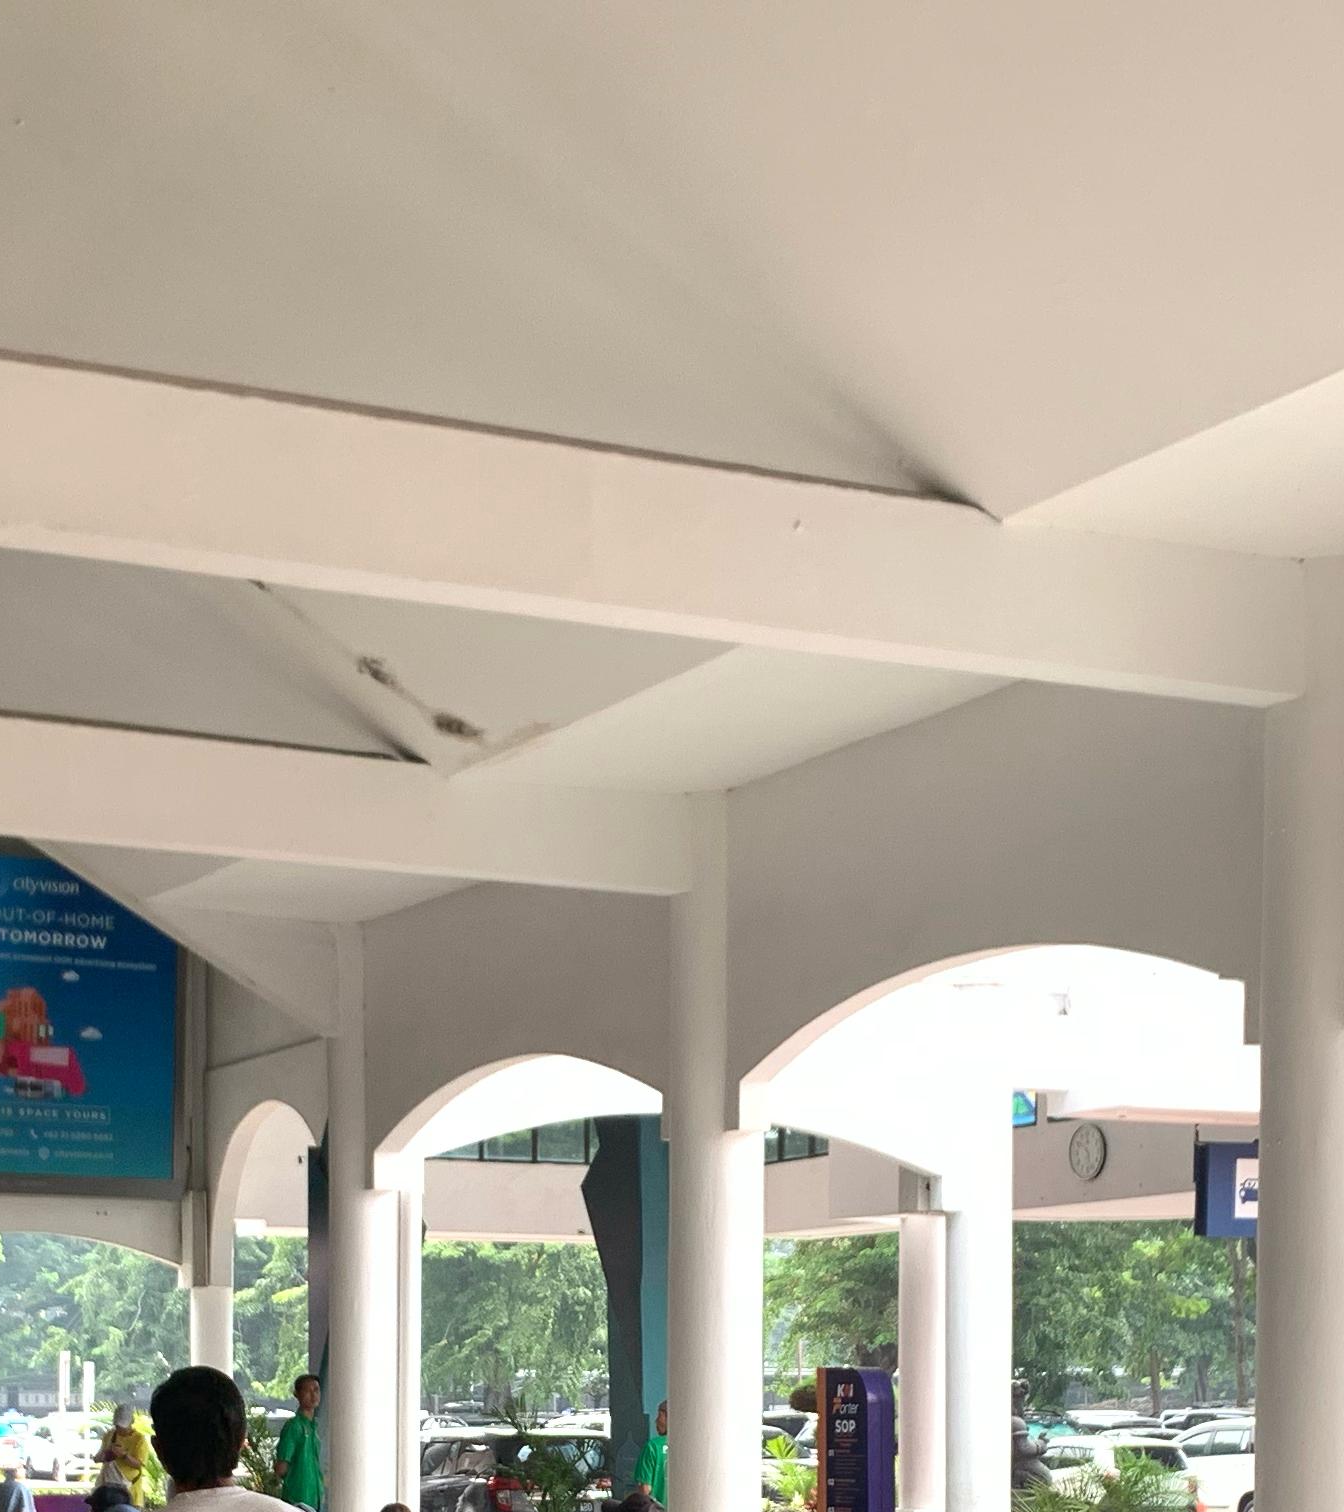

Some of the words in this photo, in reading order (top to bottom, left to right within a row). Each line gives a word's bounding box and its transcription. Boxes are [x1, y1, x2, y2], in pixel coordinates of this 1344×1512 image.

[13, 875, 80, 895] cityvision
[18, 1105, 58, 1119] SPACE
[65, 1108, 107, 1121] YOURS
[835, 1419, 857, 1433] SOP
